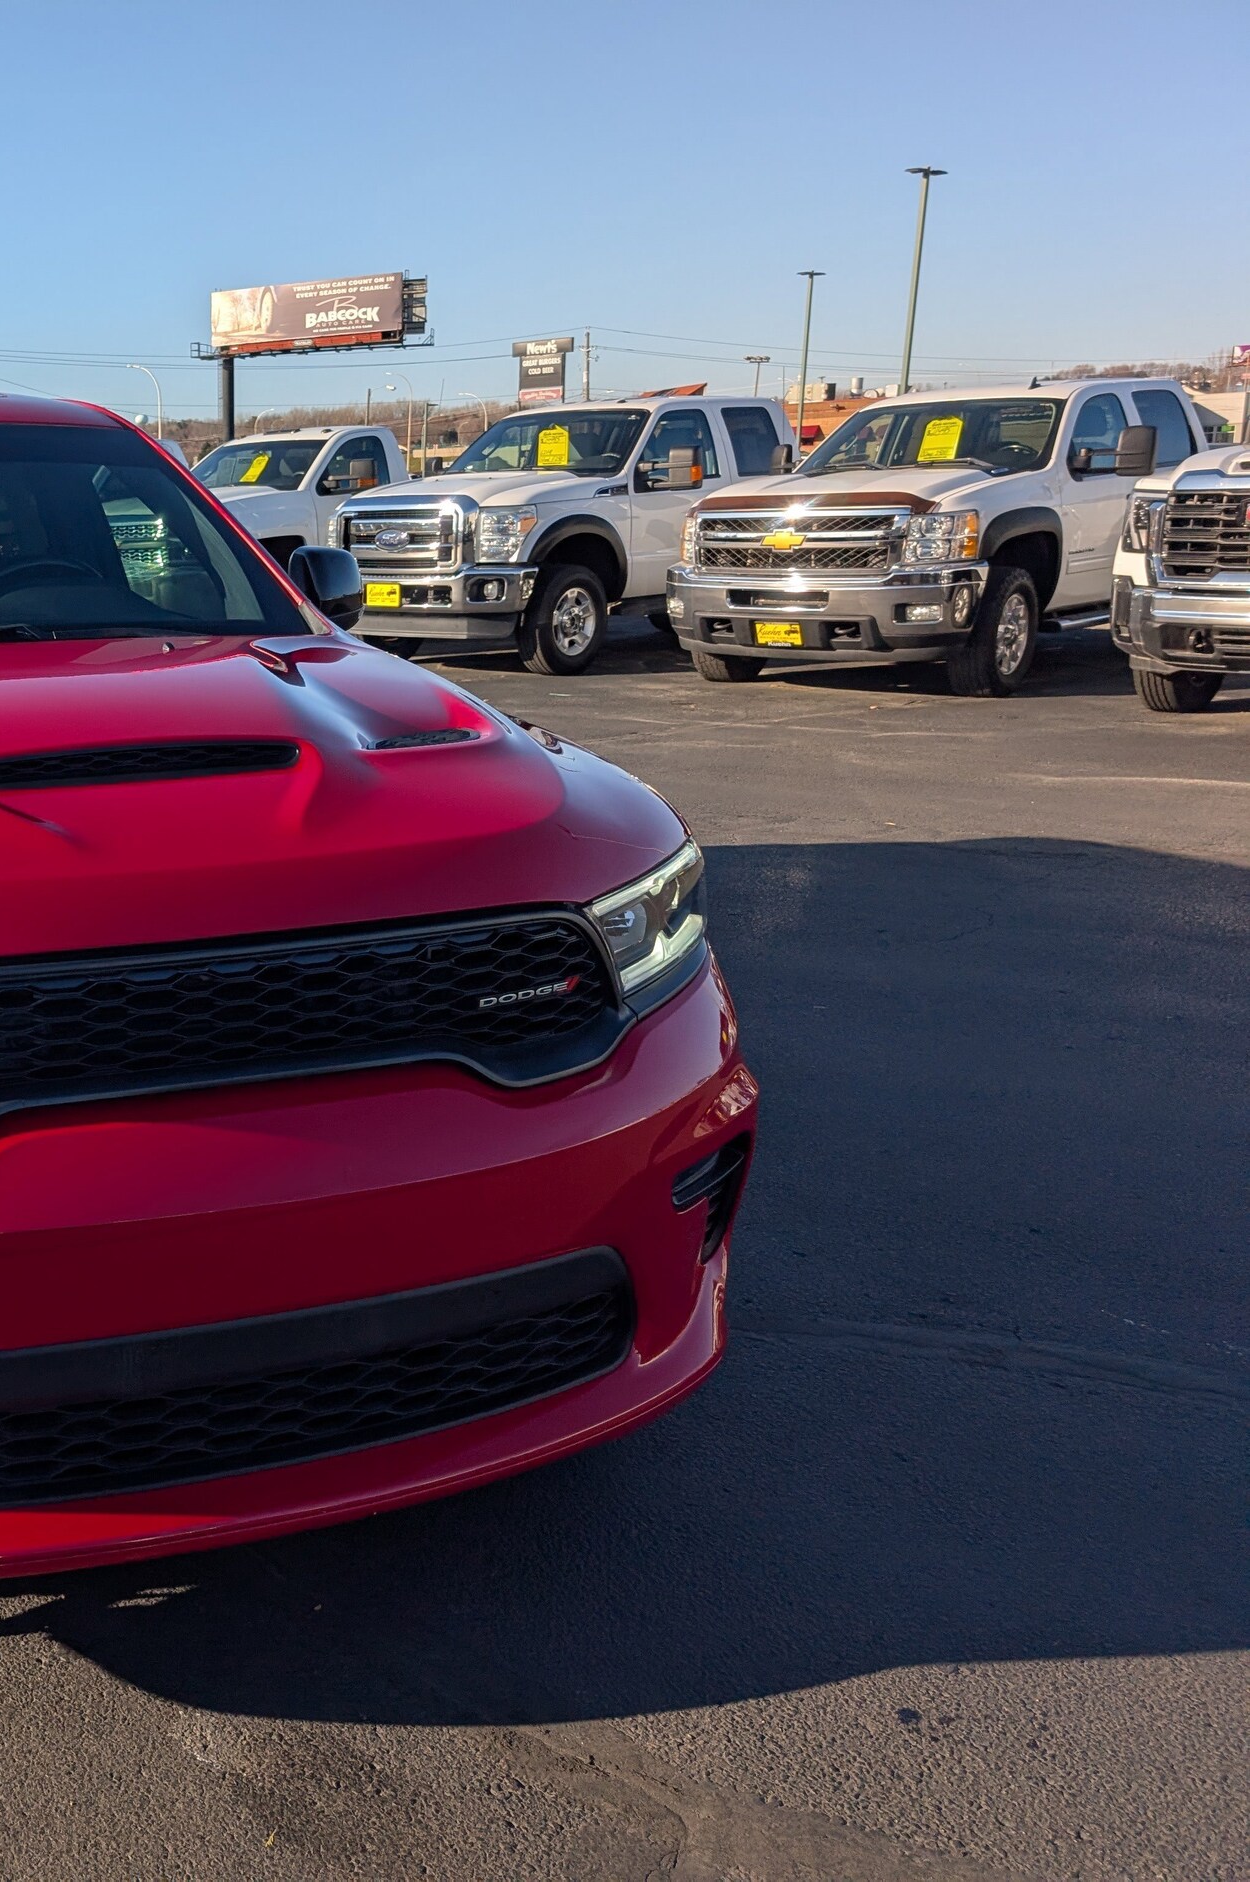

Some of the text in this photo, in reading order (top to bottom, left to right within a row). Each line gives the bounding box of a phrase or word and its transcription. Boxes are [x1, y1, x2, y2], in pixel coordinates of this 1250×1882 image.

[348, 278, 373, 286] COUNT
[295, 291, 318, 299] EVERY
[319, 288, 347, 296] SEASON
[360, 283, 392, 292] CHANGE.
[305, 306, 380, 329] BABCOCK
[526, 339, 558, 355] Newt's
[522, 357, 561, 367] GREAT BURGERS
[528, 366, 554, 375] COLD BEER
[479, 981, 569, 1008] DODGE
